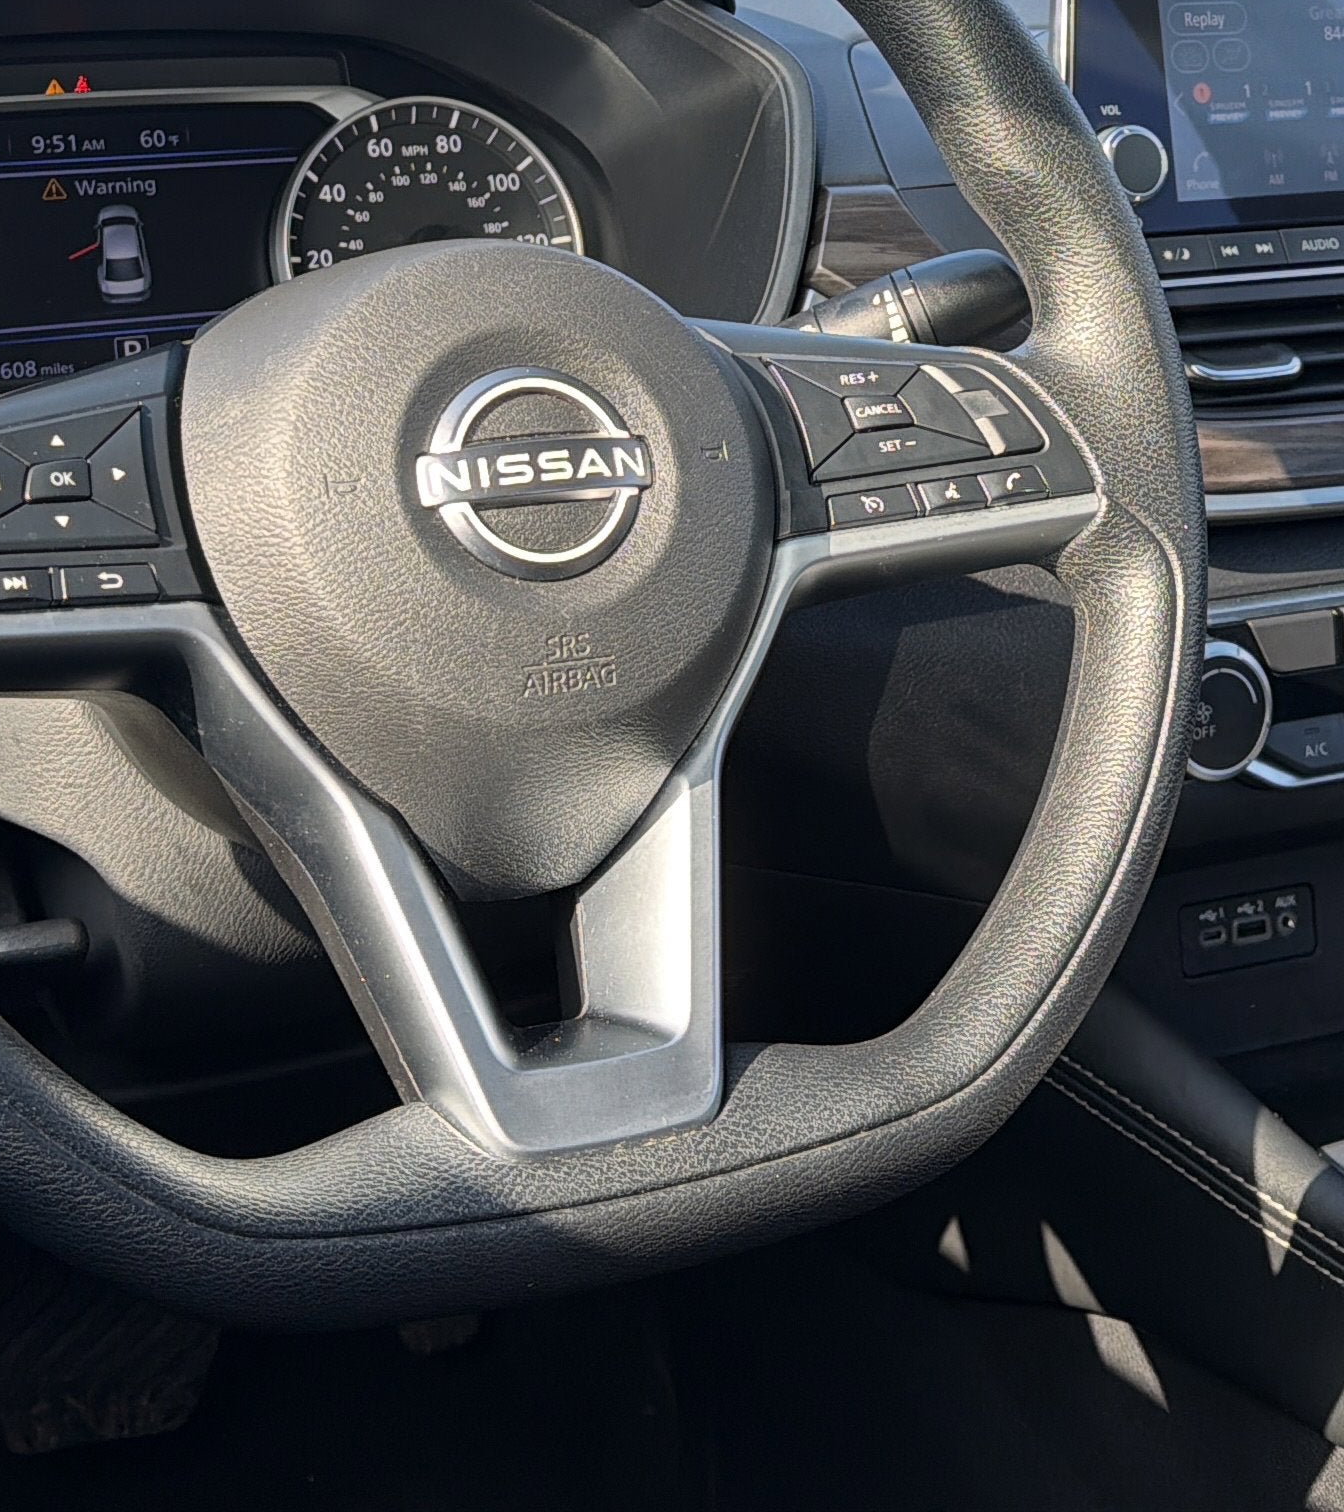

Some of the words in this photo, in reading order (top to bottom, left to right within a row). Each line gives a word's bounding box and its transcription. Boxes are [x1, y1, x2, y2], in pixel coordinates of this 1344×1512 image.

[1184, 11, 1225, 30] Replay
[1100, 104, 1122, 116] VOL
[31, 133, 78, 154] 9:51
[81, 138, 106, 151] AM
[367, 138, 394, 158] 60
[401, 144, 429, 157] MPH
[435, 134, 462, 154] 80
[74, 176, 157, 197] Warning
[391, 174, 411, 187] 100
[419, 172, 438, 185] 120
[487, 173, 521, 193] 100
[318, 183, 347, 203] 40
[368, 190, 384, 203] 80
[467, 196, 486, 208] 160
[355, 210, 371, 223] 60
[483, 221, 502, 234] 180
[348, 239, 364, 251] 40
[1300, 236, 1341, 253] AUDIO
[307, 248, 334, 270] 20
[40, 361, 74, 377] miles
[856, 402, 903, 419] CANCEL
[431, 446, 645, 492] NISSAN
[50, 470, 76, 487] OK
[545, 633, 591, 658] SRS
[522, 662, 618, 699] AIRBAG
[1192, 724, 1217, 740] OFF
[1305, 741, 1330, 757] A/C
